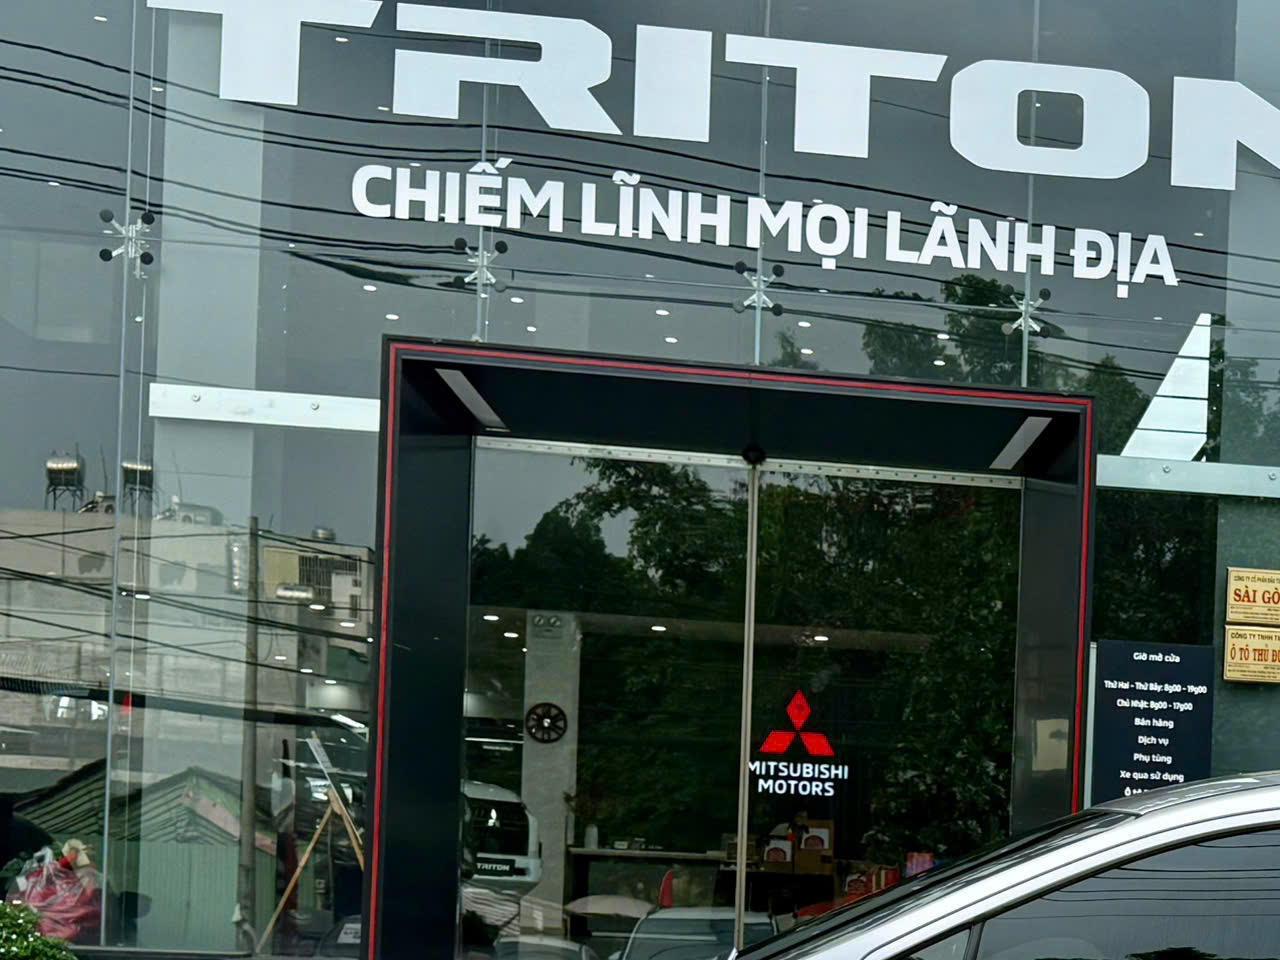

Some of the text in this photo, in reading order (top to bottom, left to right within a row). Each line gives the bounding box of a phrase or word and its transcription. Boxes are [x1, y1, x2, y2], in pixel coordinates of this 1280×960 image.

[352, 158, 1180, 298] CHIẾM LĨNH MỌI LÃNH ĐỊA
[1233, 585, 1257, 603] SÀI
[1231, 632, 1247, 640] CÔNG
[1132, 652, 1181, 663] Giờ mở cửa
[1230, 643, 1236, 661] Ô
[1239, 643, 1250, 661] TÔ
[1253, 643, 1270, 662] THỦ
[1104, 680, 1118, 689] Thứ
[1118, 681, 1130, 689] Hai
[1164, 683, 1182, 693] 8g00
[1116, 698, 1130, 707] Chủ
[1134, 717, 1174, 729] Bán hàng
[1138, 735, 1169, 746] Dịch vụ
[1133, 753, 1172, 765] Phụ tùng
[748, 760, 849, 779] MITSUBISHI
[1119, 770, 1184, 783] Xe qua sử dụng
[758, 779, 835, 797] MOTORS
[1124, 786, 1131, 796] Ô
[475, 862, 511, 872] TRITON
